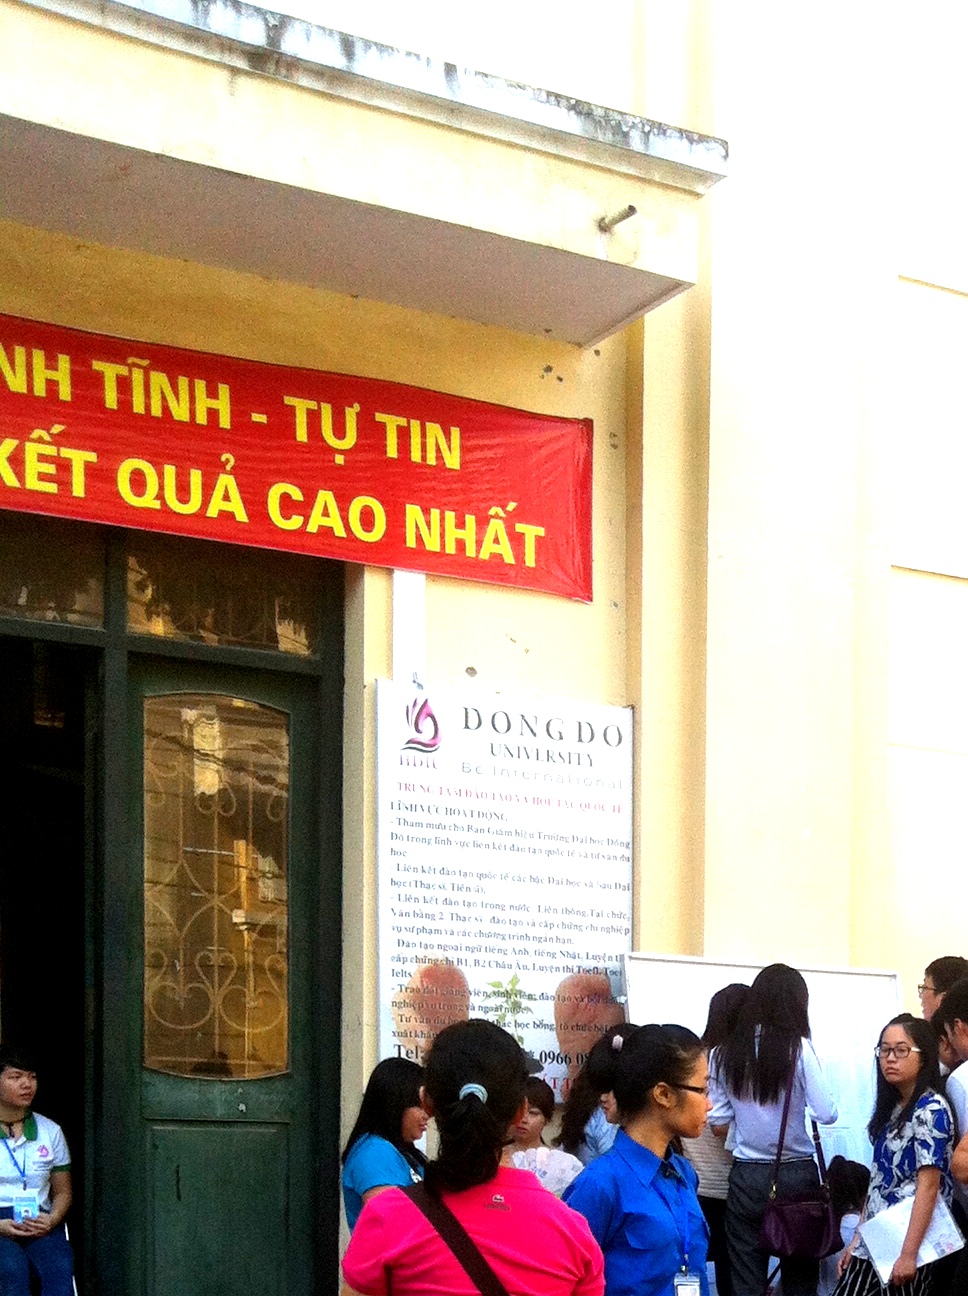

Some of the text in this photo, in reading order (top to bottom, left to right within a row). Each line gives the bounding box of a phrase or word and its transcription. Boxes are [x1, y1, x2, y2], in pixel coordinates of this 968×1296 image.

[0, 342, 71, 402] NH
[92, 357, 231, 429] TĨNH
[283, 395, 361, 465] TỰ
[374, 412, 460, 470] TIN
[0, 424, 546, 568] KẾT QUẢ CAO NHẤT
[490, 742, 593, 767] UNIVERSITY
[540, 1050, 572, 1065] 0966
